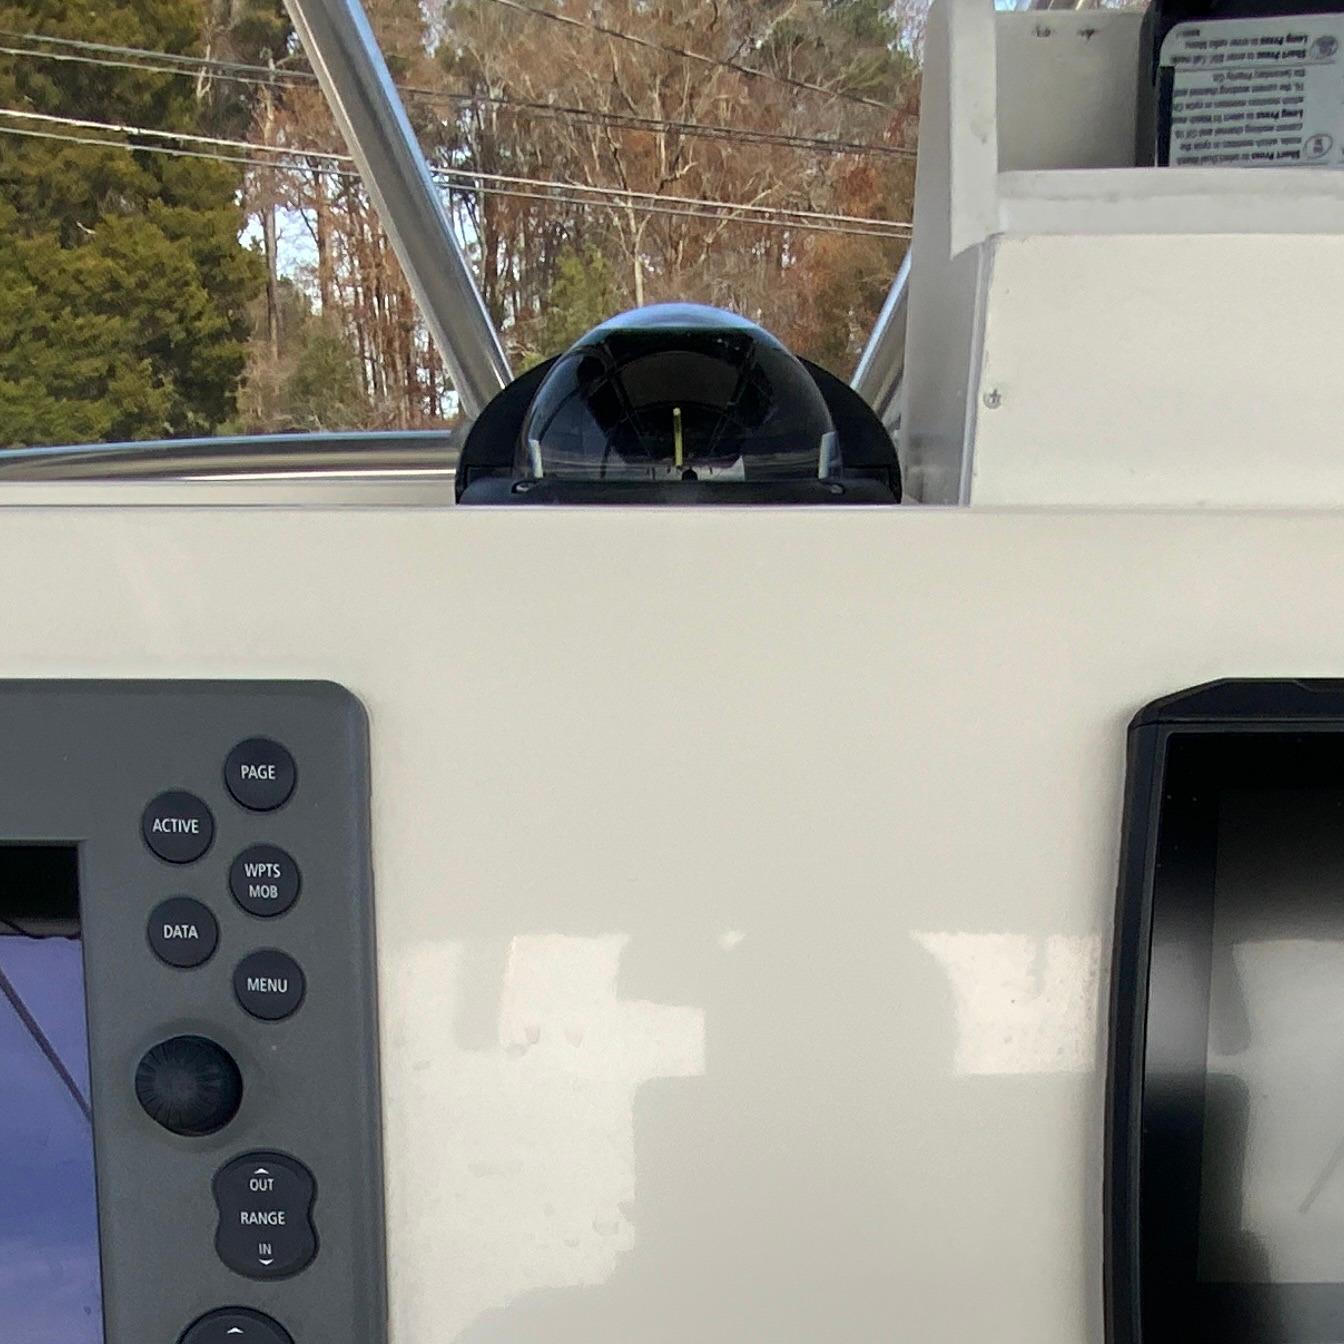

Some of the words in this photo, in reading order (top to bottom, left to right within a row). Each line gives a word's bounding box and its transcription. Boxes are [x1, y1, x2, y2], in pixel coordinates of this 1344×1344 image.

[240, 764, 276, 781] PAGE
[152, 818, 199, 834] ACTIVE
[244, 863, 281, 879] WPTS
[248, 883, 278, 899] MOB
[163, 924, 198, 940] DATA
[247, 976, 288, 993] MENU
[249, 1177, 274, 1192] OUT
[240, 1210, 286, 1226] RANGE
[258, 1241, 272, 1256] IN
